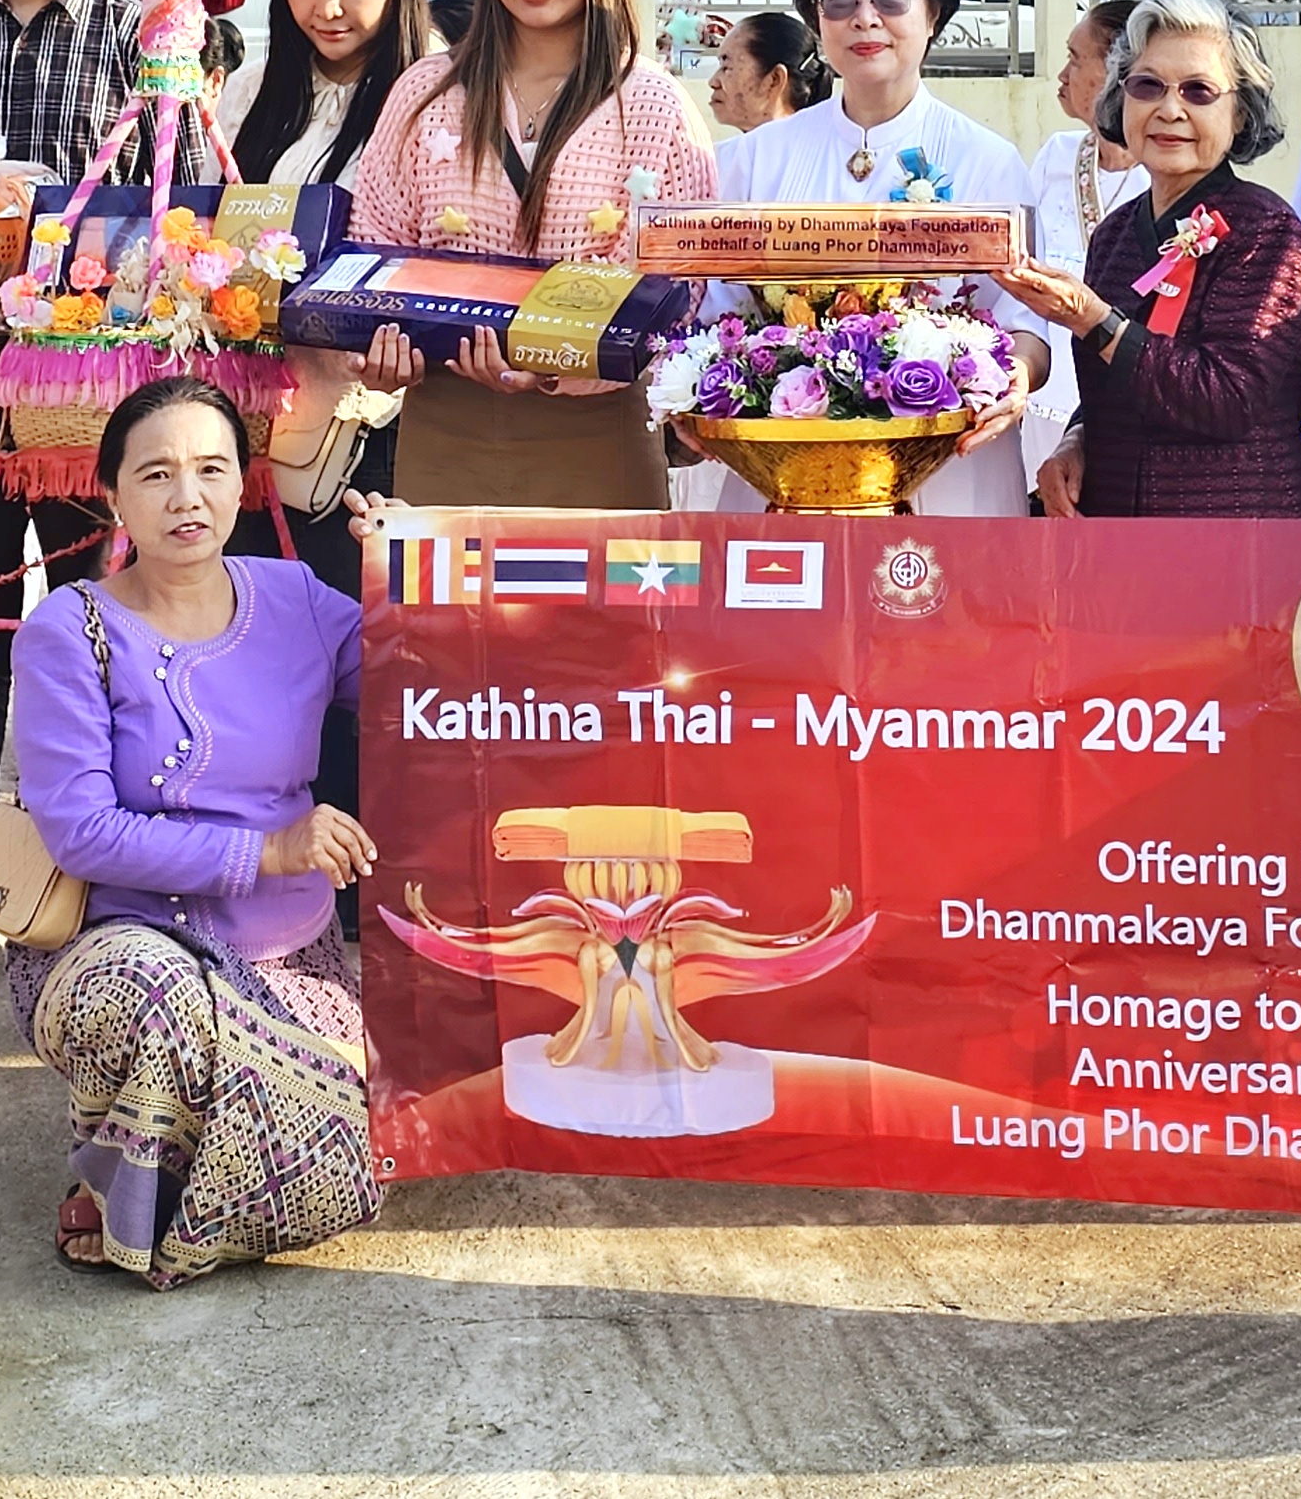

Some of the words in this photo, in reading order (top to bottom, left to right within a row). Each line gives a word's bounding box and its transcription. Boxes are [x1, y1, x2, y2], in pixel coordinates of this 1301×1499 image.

[647, 214, 706, 231] Kathina
[710, 215, 772, 234] Offering
[776, 217, 796, 234] by
[800, 216, 906, 236] Dhammakaya
[910, 217, 1000, 235] Foundation
[676, 239, 699, 251] on
[701, 234, 749, 251] behalf
[752, 235, 768, 251] of
[772, 237, 821, 256] Luang
[825, 238, 862, 254] Phor
[867, 239, 970, 257] Dhammajayo
[402, 686, 604, 743] Kathina
[616, 691, 733, 744] Thai
[750, 717, 776, 730] -
[795, 693, 1067, 762] Myanmar
[1080, 698, 1227, 755] 2024
[1097, 839, 1288, 898] Offering
[940, 899, 1248, 956] Dhammakaya
[1046, 984, 1243, 1042] Homage
[950, 1104, 1087, 1160] Luang
[1102, 1107, 1211, 1155] Phor
